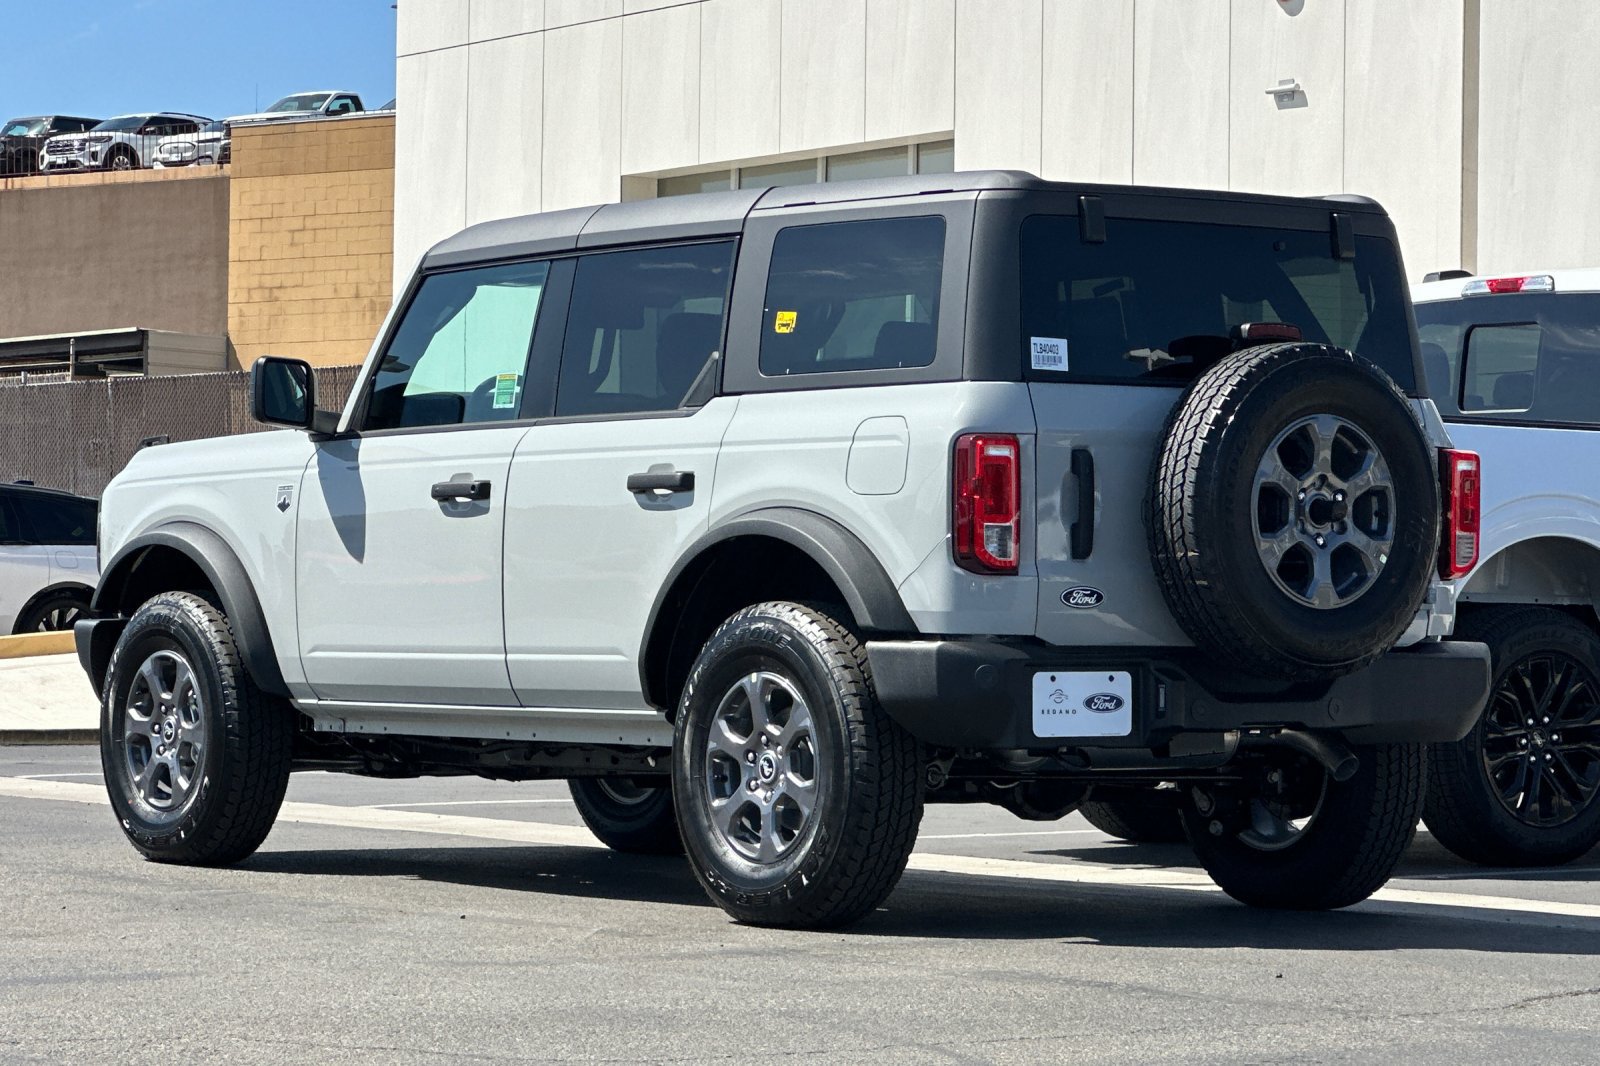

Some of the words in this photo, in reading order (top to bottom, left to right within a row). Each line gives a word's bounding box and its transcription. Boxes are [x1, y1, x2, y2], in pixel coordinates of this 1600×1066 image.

[1033, 343, 1058, 355] TLB40403
[1070, 590, 1097, 604] Ford
[1091, 695, 1116, 709] Ford
